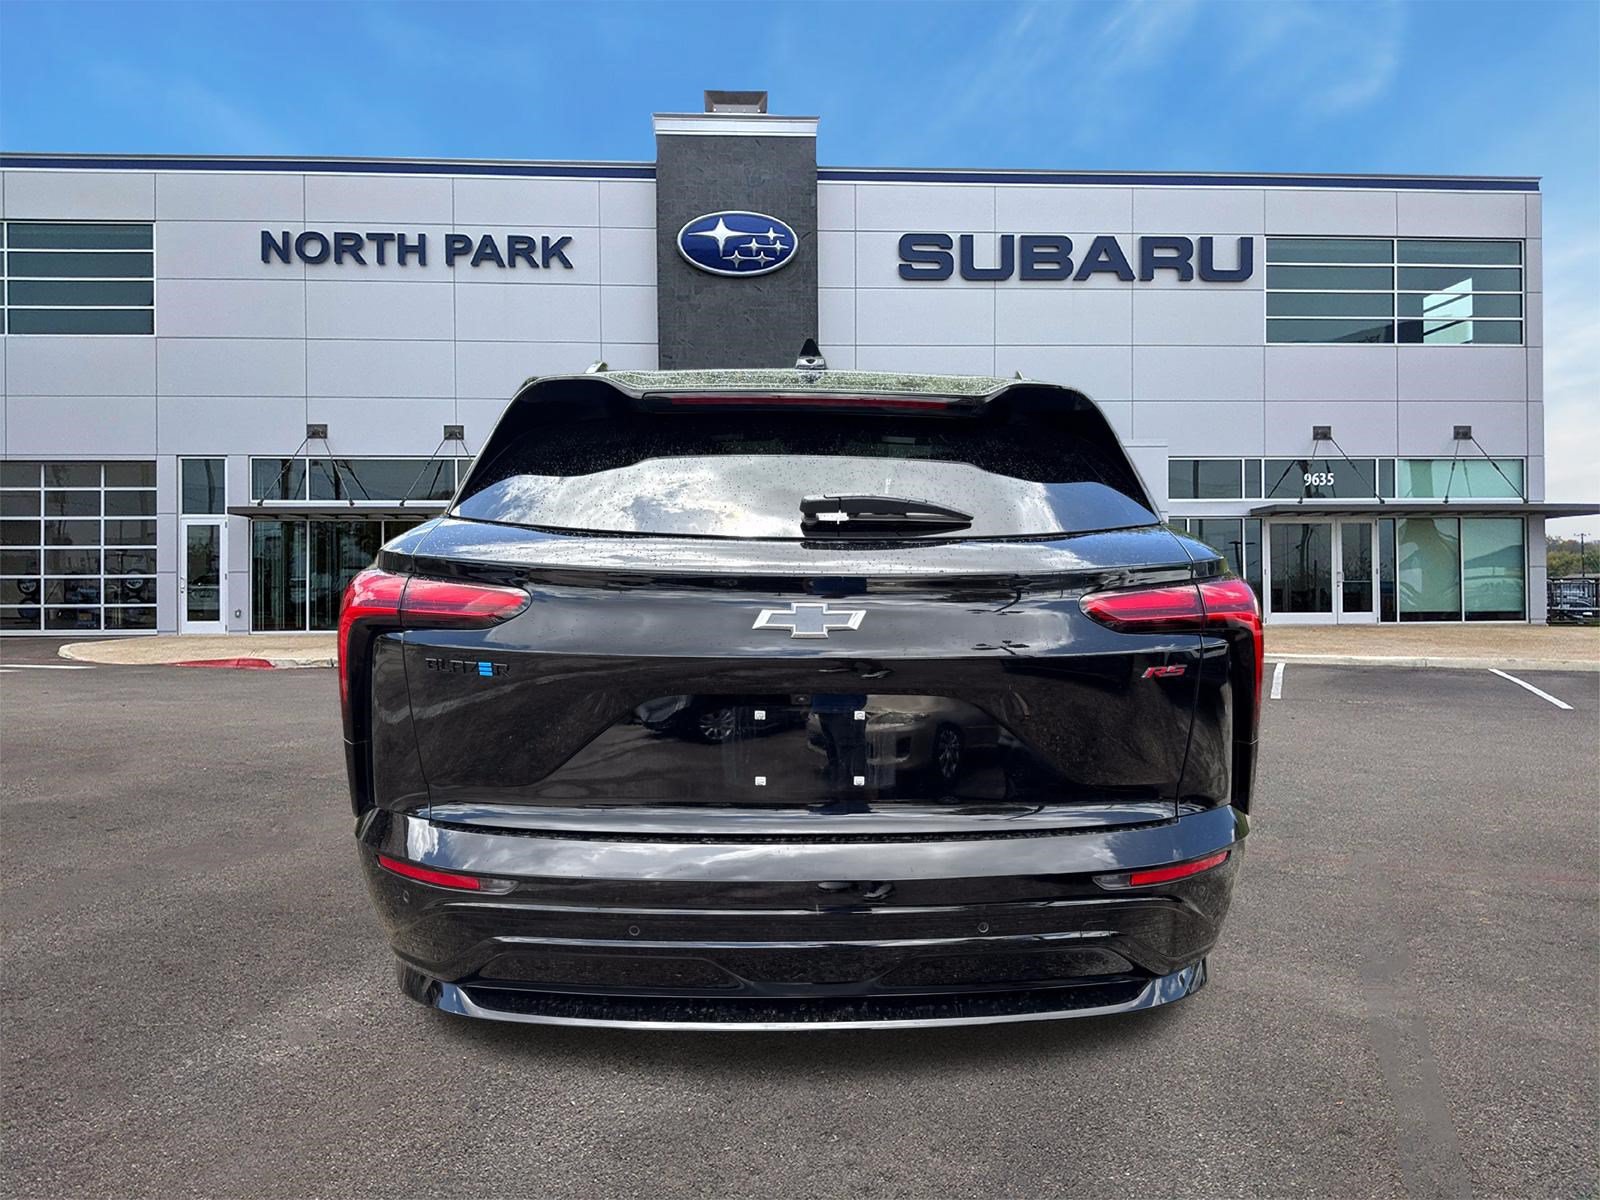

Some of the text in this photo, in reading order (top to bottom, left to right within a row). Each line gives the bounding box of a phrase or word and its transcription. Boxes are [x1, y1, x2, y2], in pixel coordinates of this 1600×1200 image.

[260, 230, 574, 269] NORTH PARK
[898, 233, 1254, 282] SUBARU
[1303, 472, 1335, 486] 9635
[1141, 664, 1188, 678] RS
